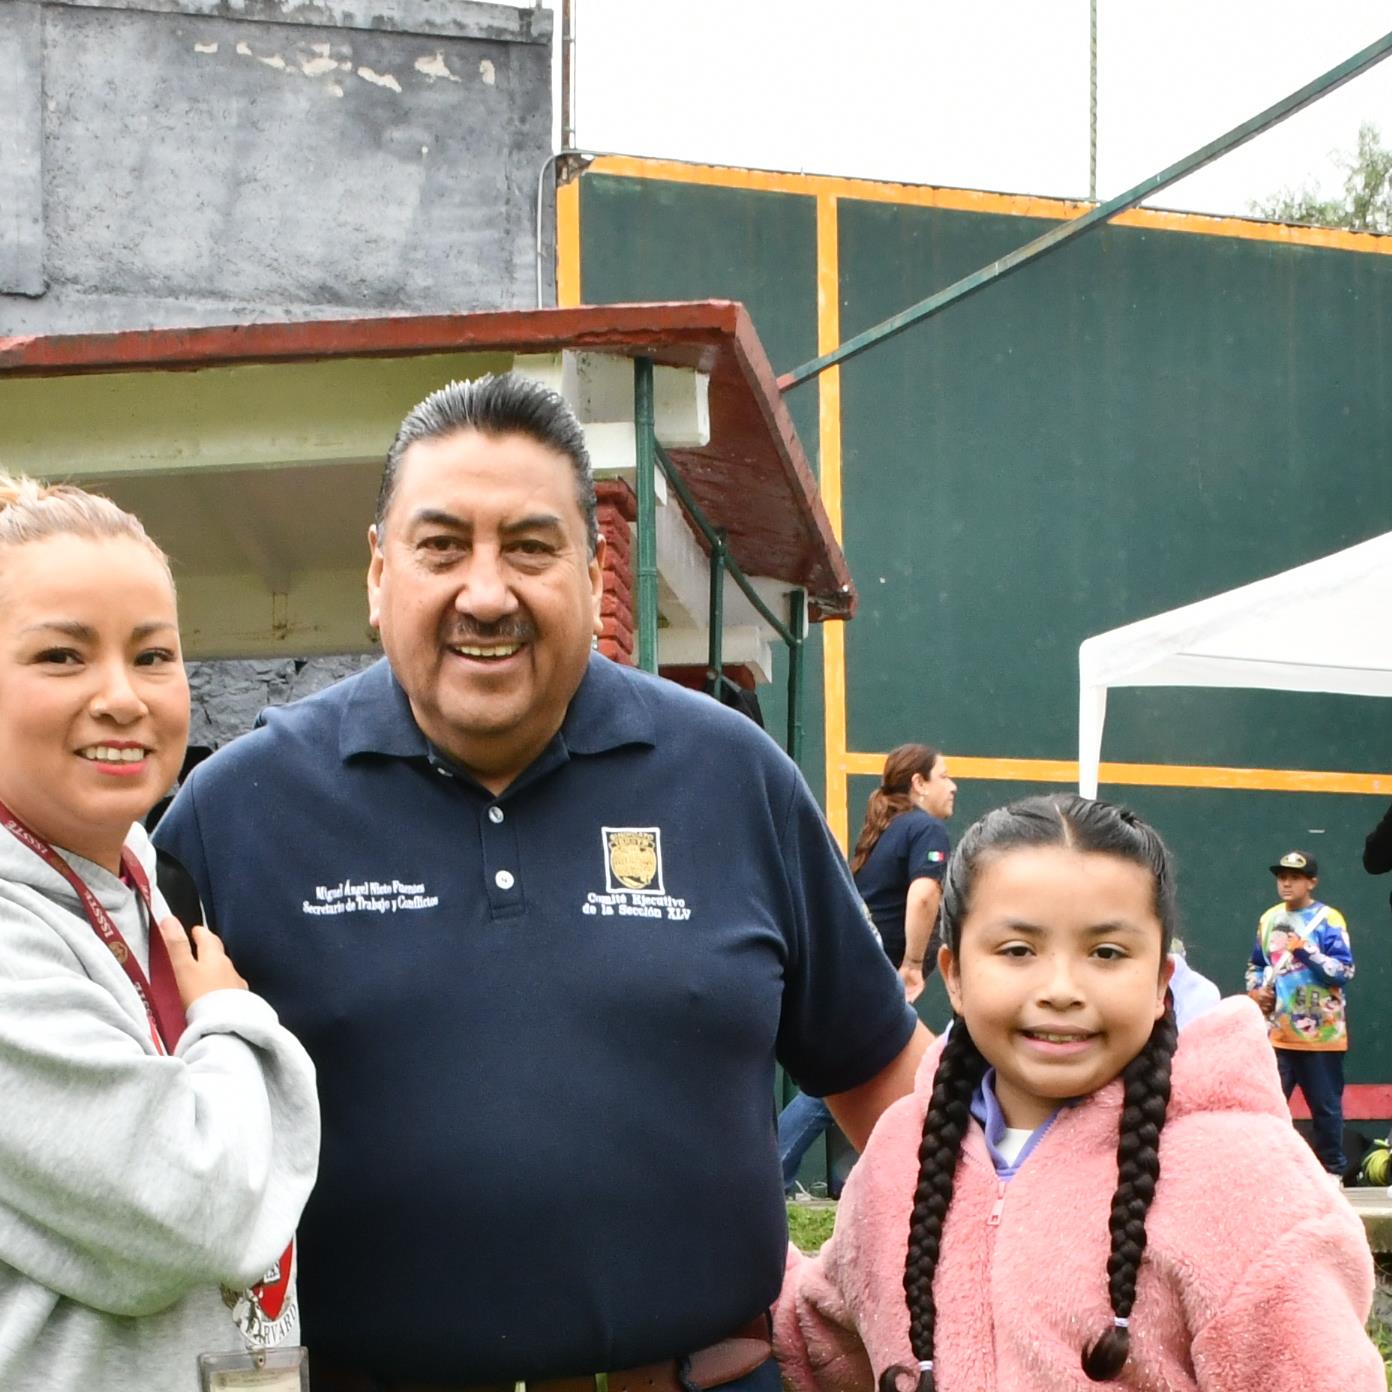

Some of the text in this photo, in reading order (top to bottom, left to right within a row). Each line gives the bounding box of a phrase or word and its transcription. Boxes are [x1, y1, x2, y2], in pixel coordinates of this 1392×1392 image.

[315, 883, 344, 902] Miguel
[587, 892, 686, 908] Comité Ejecutivo
[345, 897, 356, 912] de
[356, 895, 390, 913] Trabajo
[582, 902, 691, 920] de la Sección XLV
